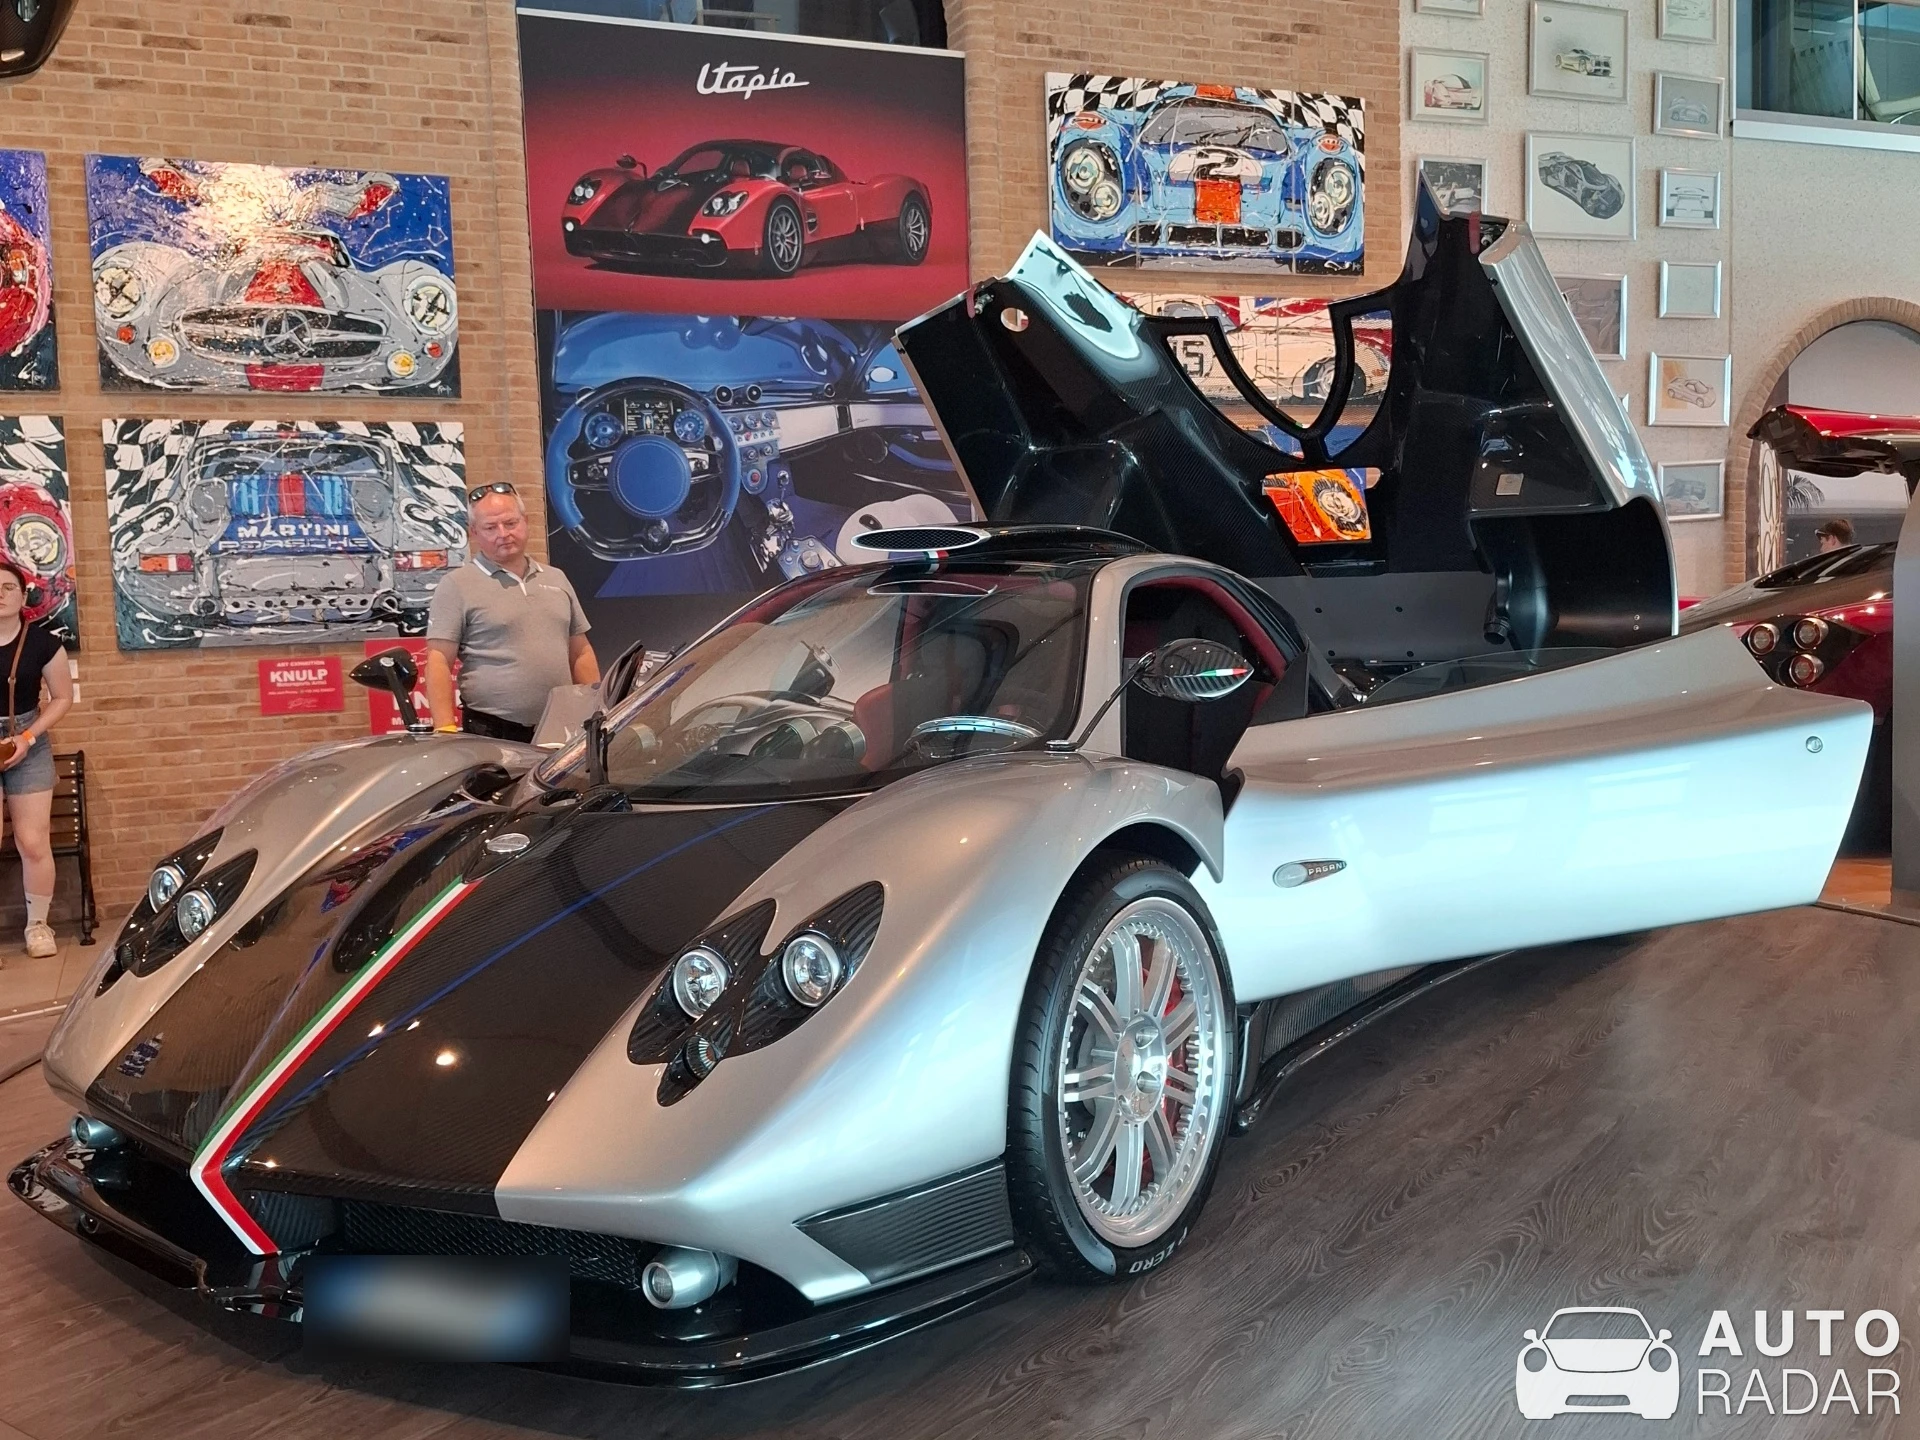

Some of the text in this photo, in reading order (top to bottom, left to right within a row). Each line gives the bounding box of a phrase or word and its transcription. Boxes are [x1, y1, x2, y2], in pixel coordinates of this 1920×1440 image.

[697, 61, 810, 100] Utopia
[237, 523, 349, 538] MARTINI
[218, 537, 369, 551] PORSCHE
[270, 668, 328, 683] KNULP
[1129, 1241, 1176, 1274] ZERO
